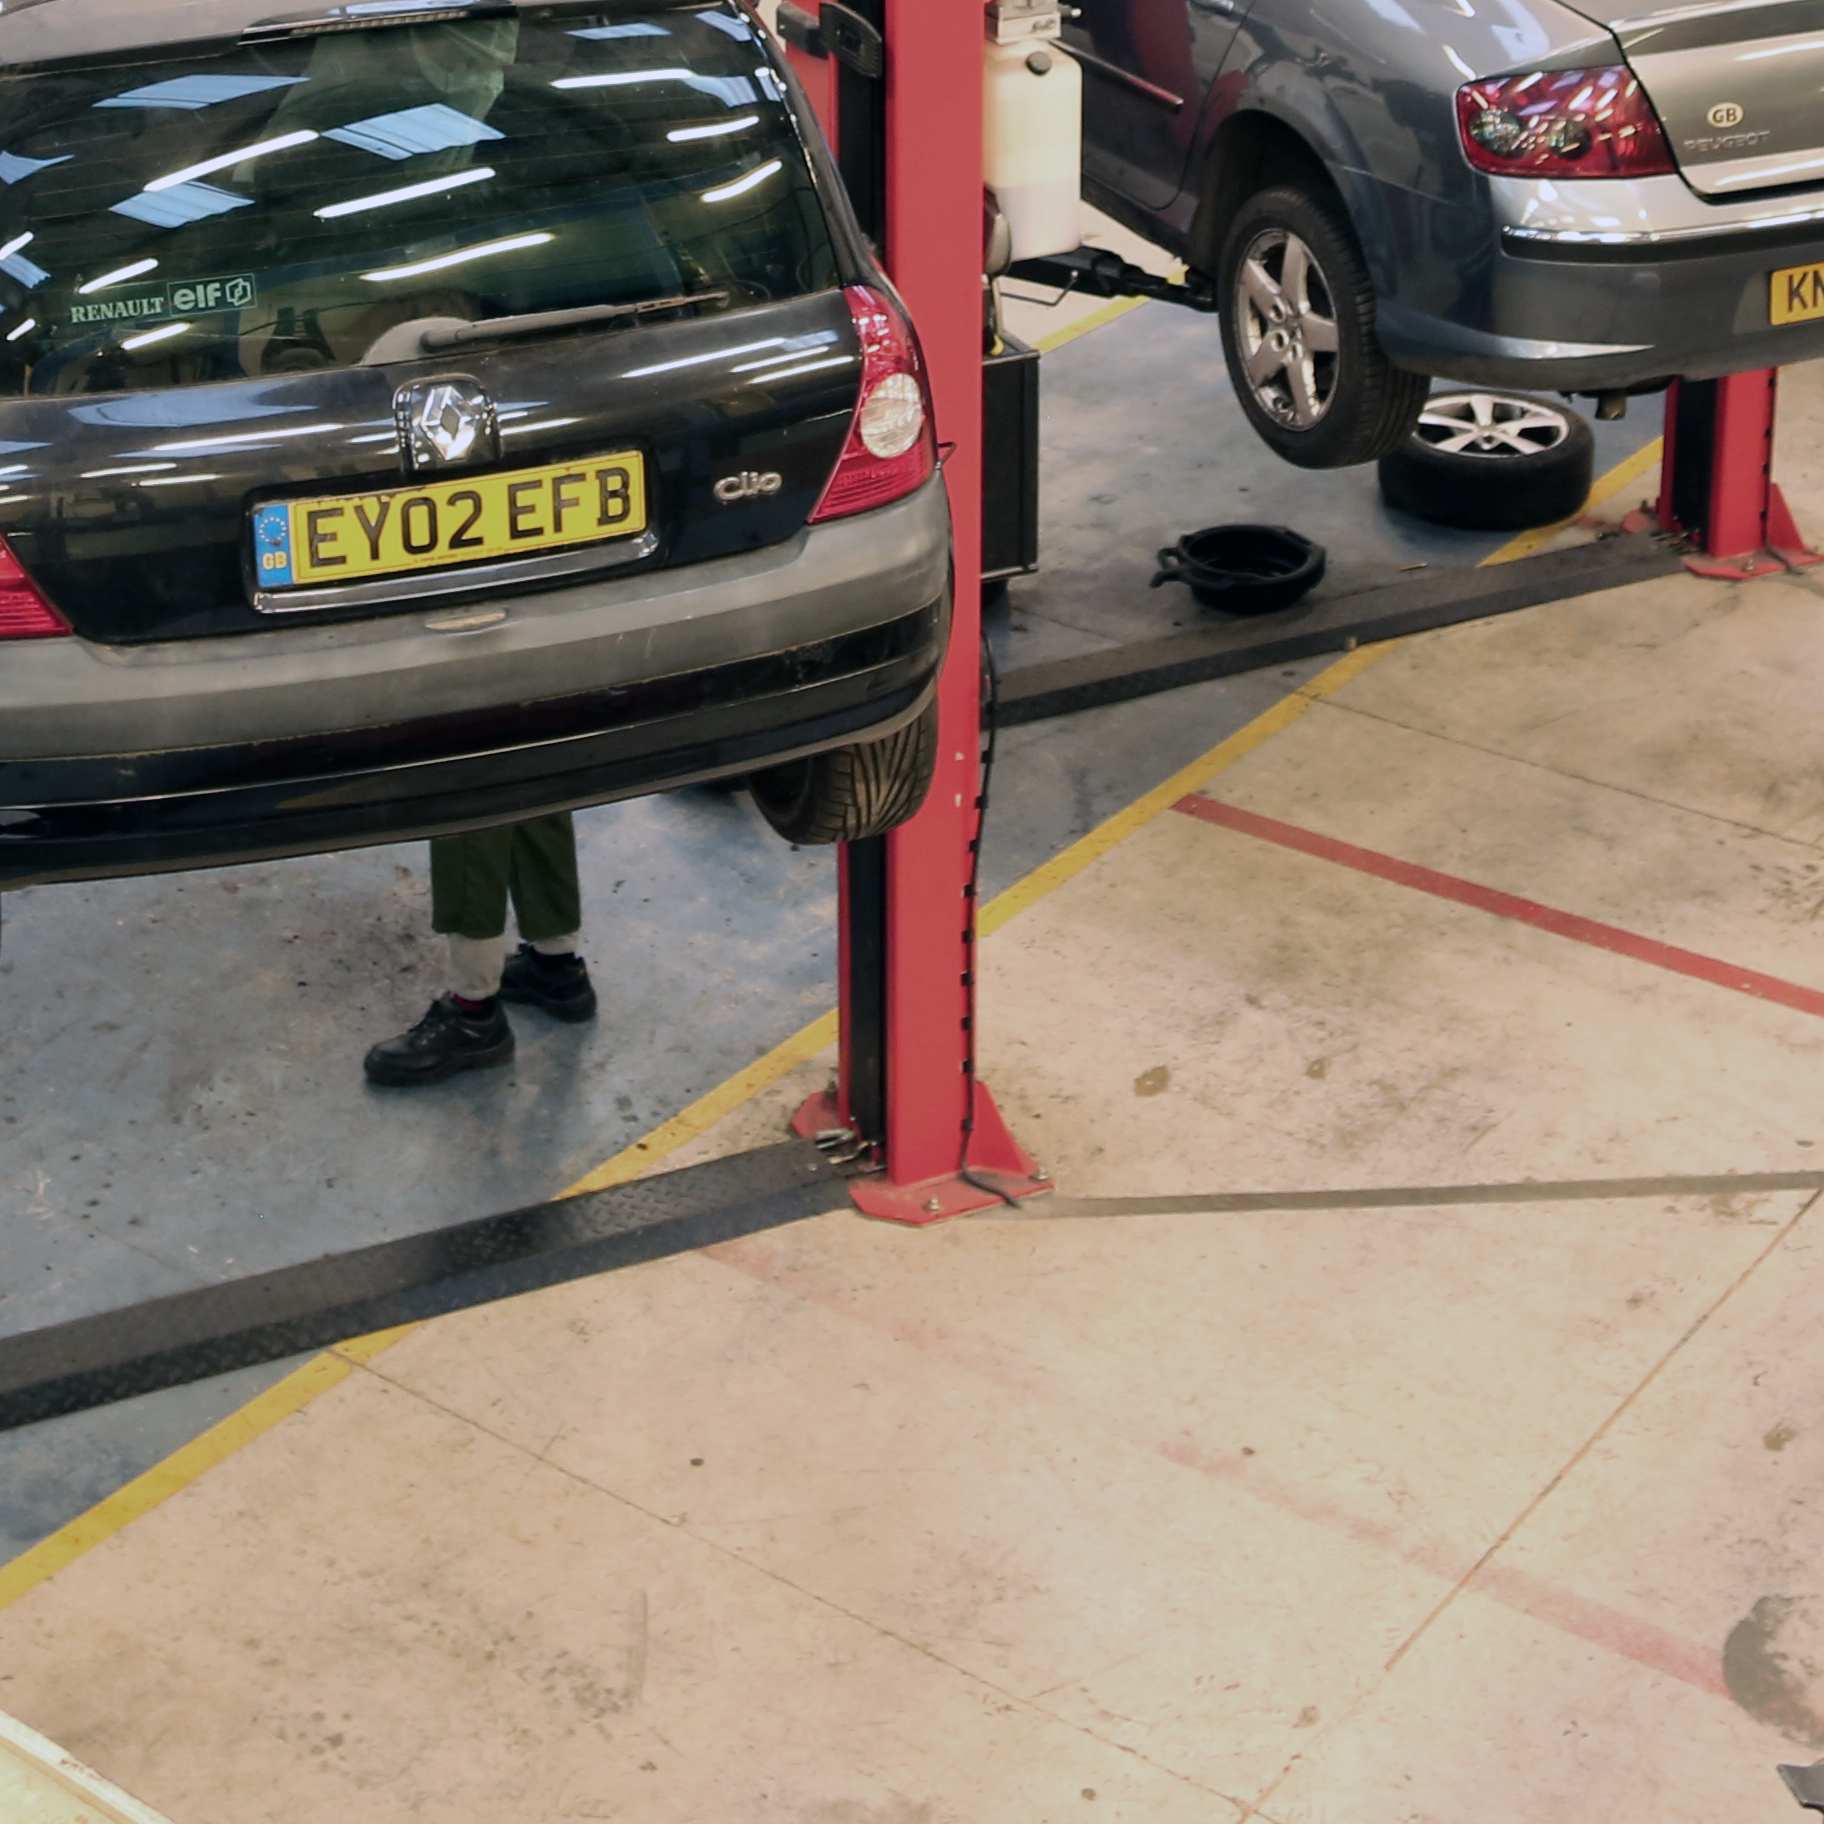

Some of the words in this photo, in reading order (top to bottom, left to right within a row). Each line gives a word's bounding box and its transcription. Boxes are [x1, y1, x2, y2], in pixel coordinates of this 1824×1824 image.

[1711, 107, 1739, 124] GB
[1683, 130, 1771, 153] PEUGEOT
[69, 296, 165, 324] RENAULT
[172, 281, 222, 311] elf
[305, 489, 484, 570] EY02
[506, 466, 633, 542] EFB
[261, 551, 288, 571] GB
